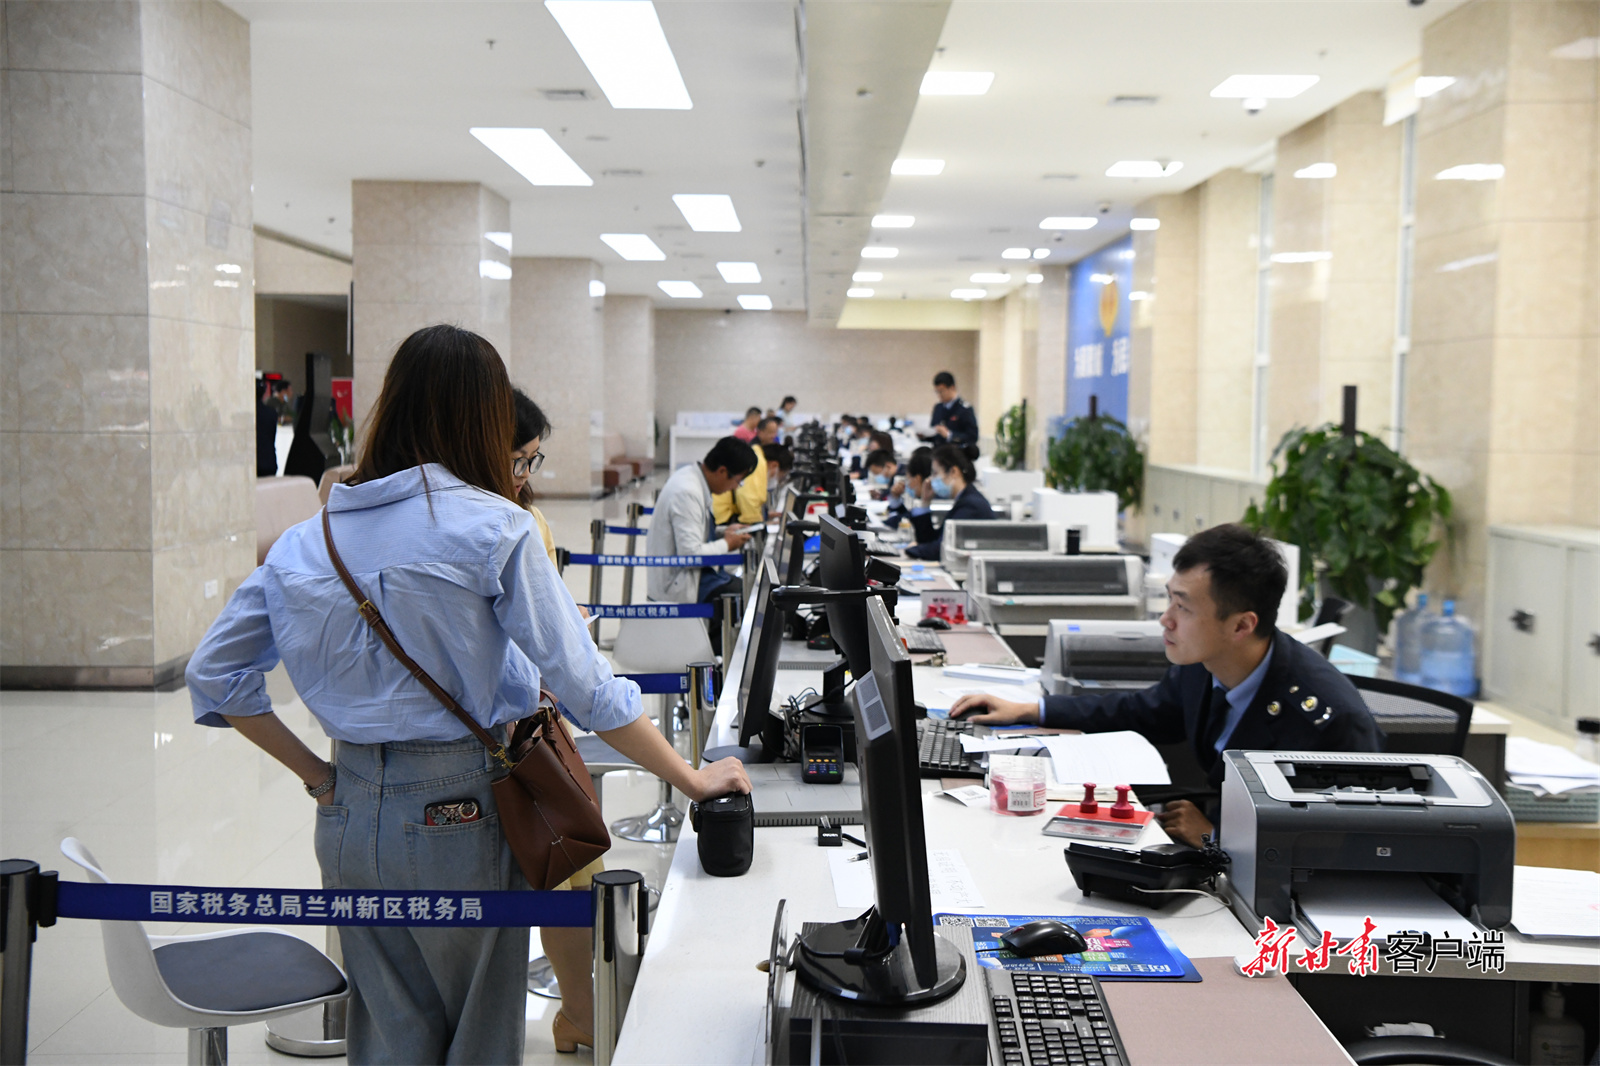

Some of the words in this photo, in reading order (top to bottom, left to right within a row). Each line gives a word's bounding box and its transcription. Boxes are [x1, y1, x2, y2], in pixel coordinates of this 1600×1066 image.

[150, 890, 483, 921] 国家税务总局兰州新区税务局
